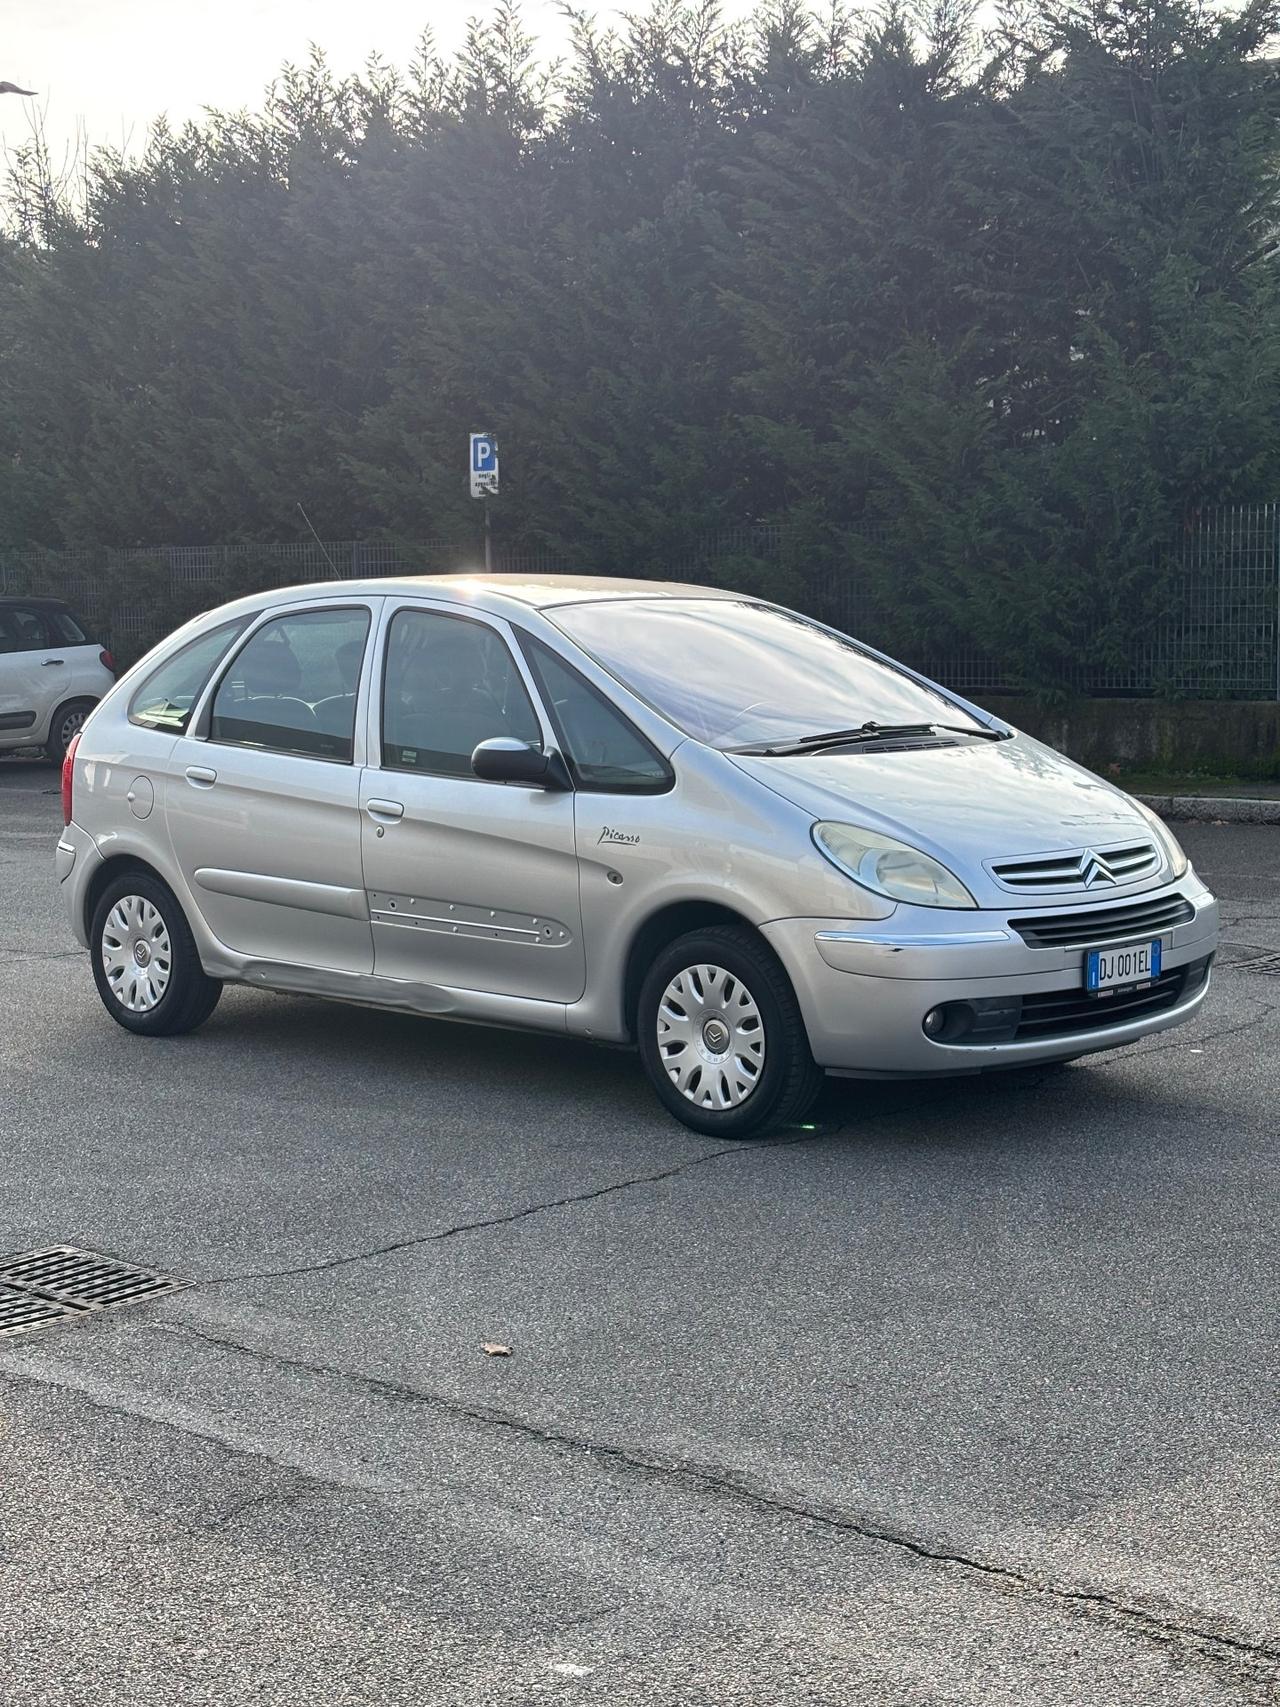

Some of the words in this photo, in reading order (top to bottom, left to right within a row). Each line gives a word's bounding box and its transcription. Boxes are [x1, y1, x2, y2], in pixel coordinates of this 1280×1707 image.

[477, 442, 491, 468] P
[597, 825, 641, 846] Picasso
[1100, 956, 1115, 981] DJ
[1117, 949, 1151, 977] 001EL
